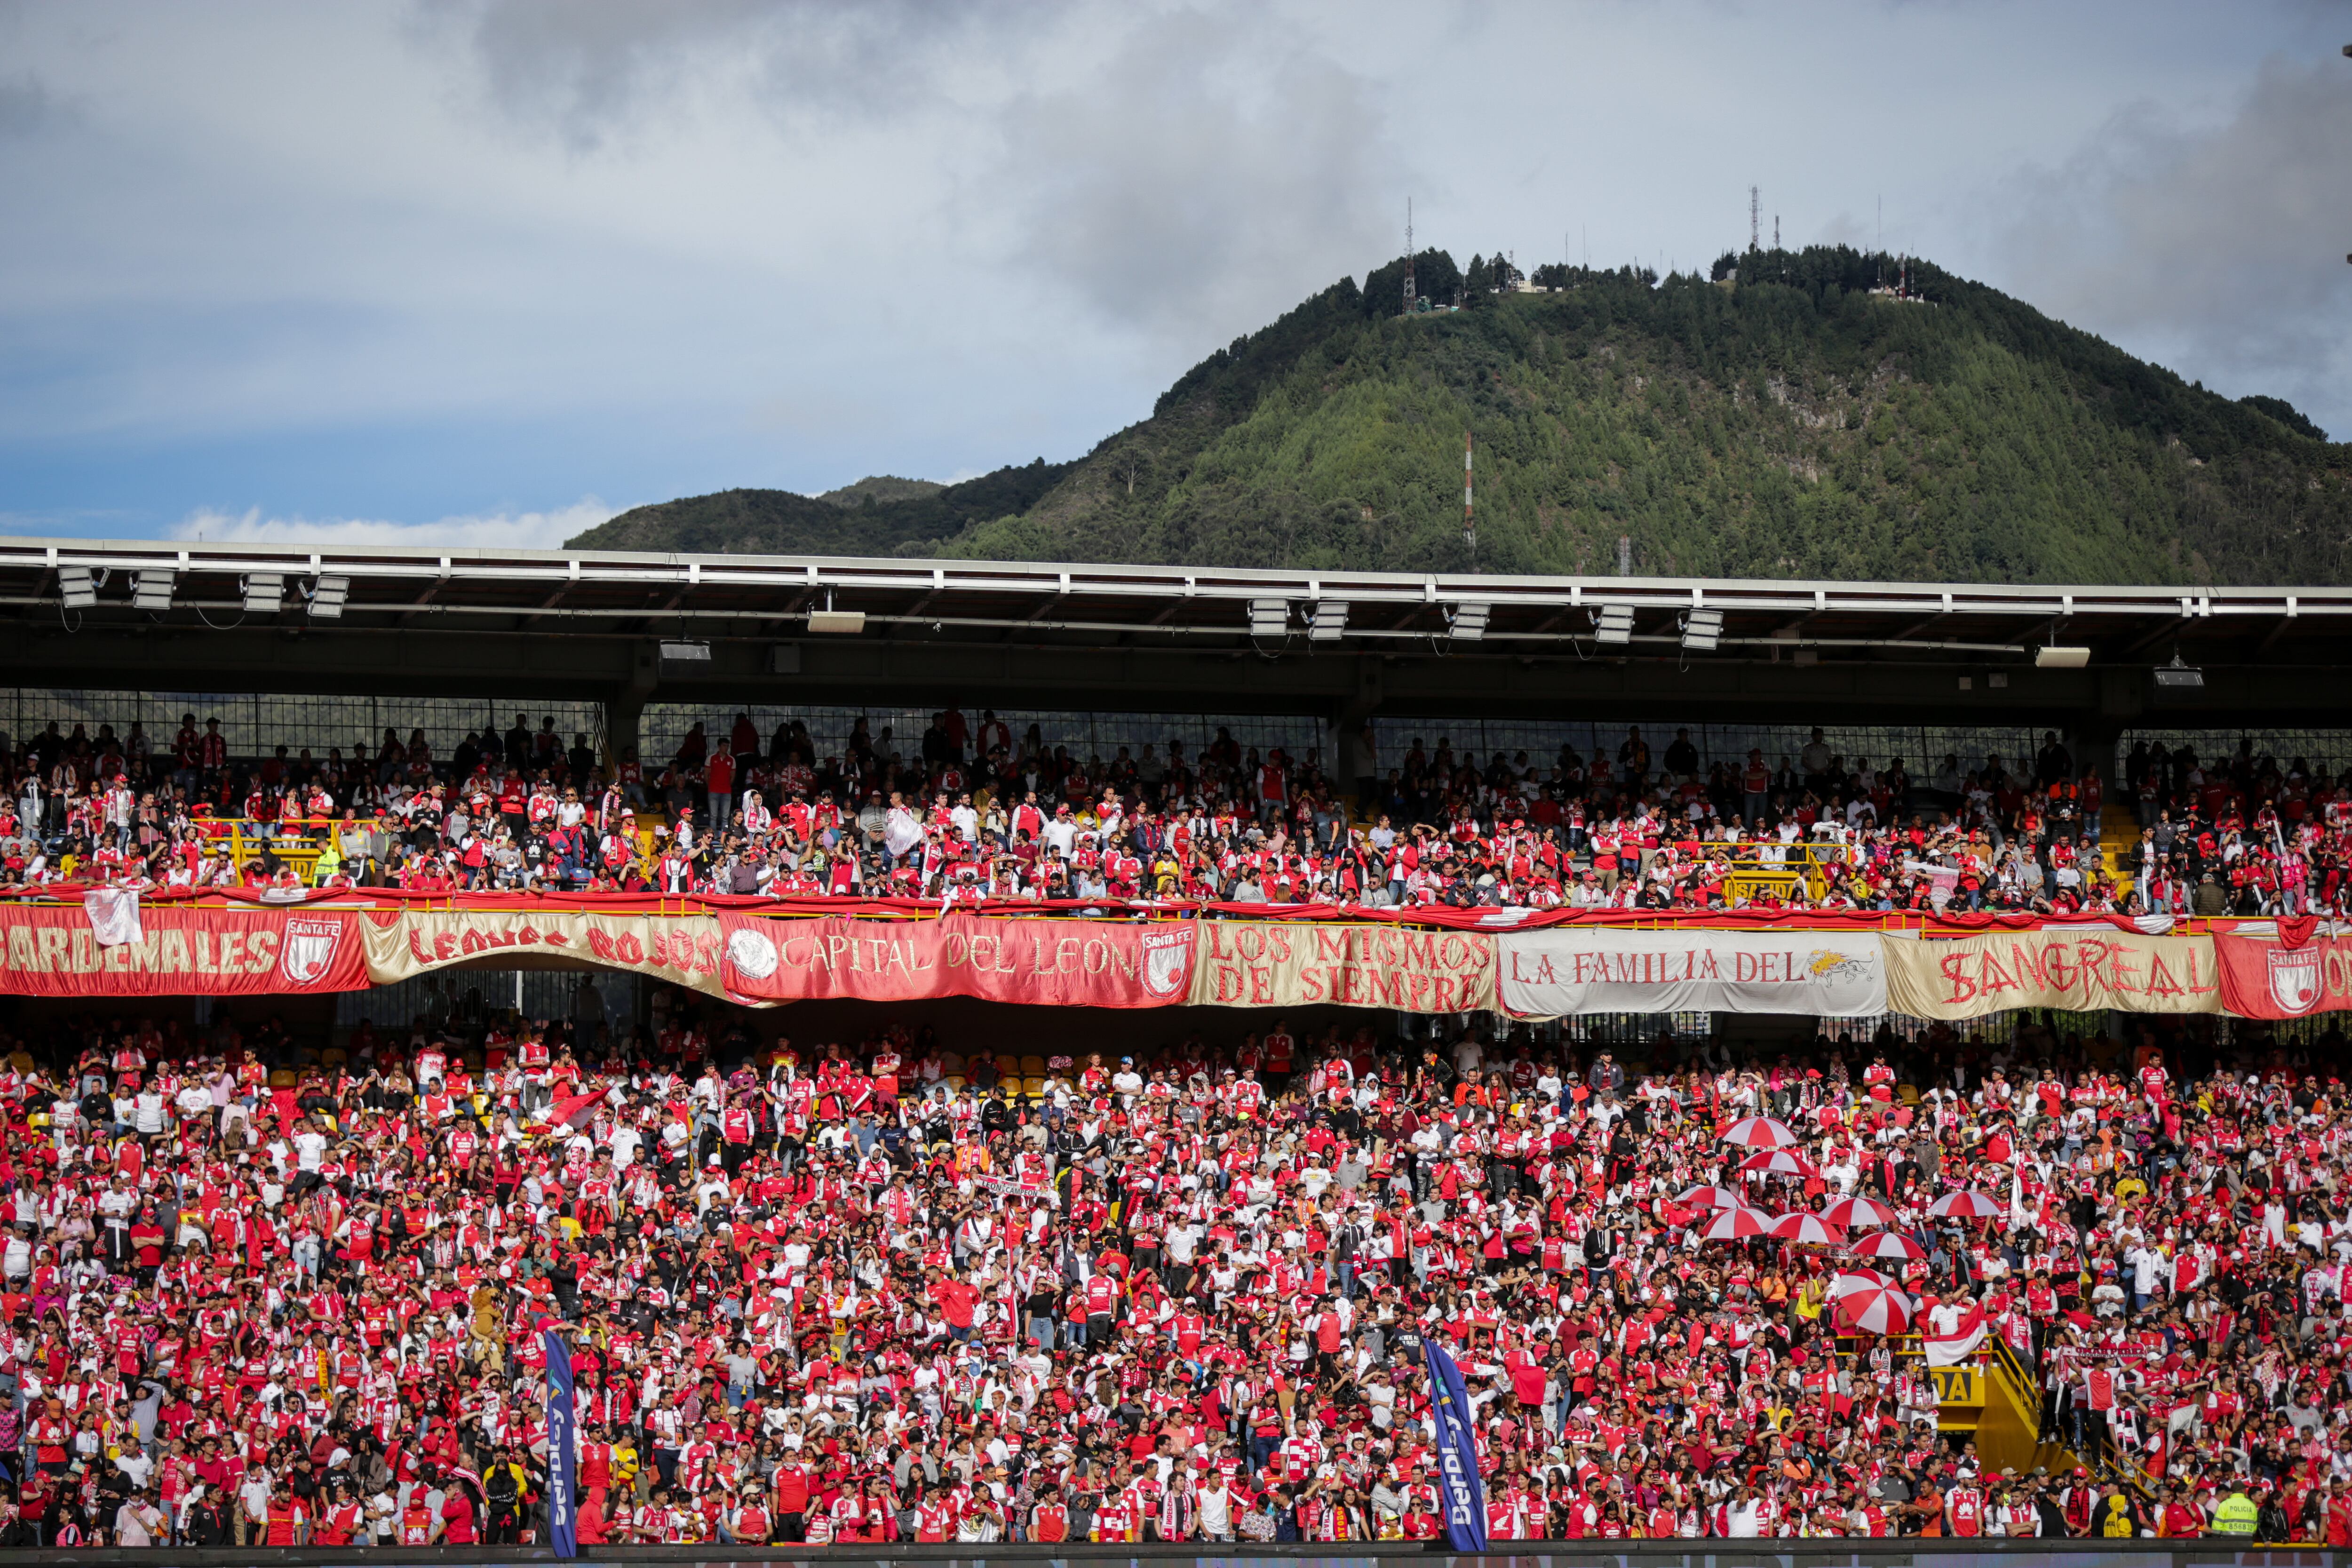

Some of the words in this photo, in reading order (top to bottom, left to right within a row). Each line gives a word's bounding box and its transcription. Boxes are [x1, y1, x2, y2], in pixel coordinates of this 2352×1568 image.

[0, 926, 278, 974] ARDENALES
[586, 927, 721, 977] ROJOS
[1145, 933, 1175, 948] SANTA
[1176, 929, 1191, 942] FE
[1206, 923, 1291, 963] LOS
[1314, 927, 1491, 970] MISMOS
[782, 934, 933, 993] CAPITAL
[946, 932, 1016, 973] DEL
[1511, 951, 1556, 985] LA
[1573, 948, 1719, 985] FAMILIA
[1734, 951, 1805, 983] DEL
[1215, 965, 1274, 1004] DE
[1300, 965, 1481, 1012] SIEMPRE
[1804, 1246, 1828, 1255] SOMOS
